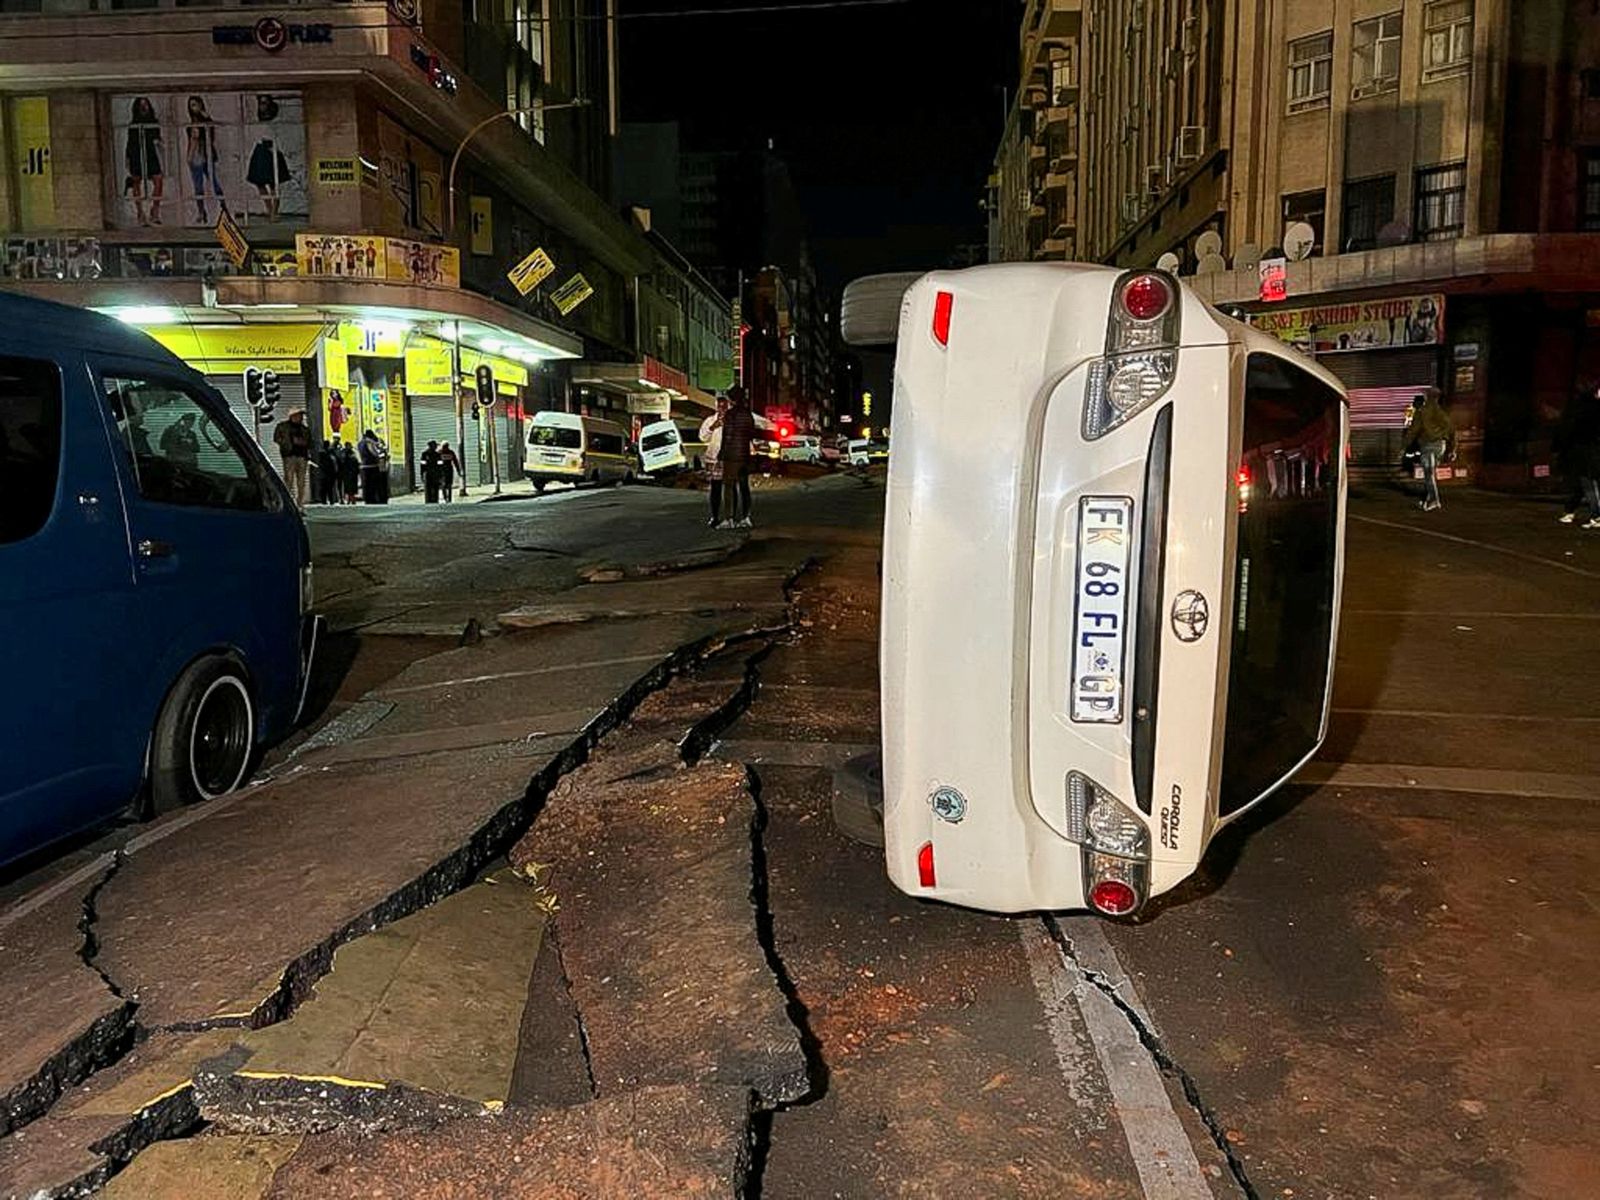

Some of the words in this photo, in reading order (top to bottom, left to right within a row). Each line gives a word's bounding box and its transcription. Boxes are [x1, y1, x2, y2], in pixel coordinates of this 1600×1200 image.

[319, 161, 354, 169] WELCOME
[319, 172, 354, 181] UPSTAIRS
[1301, 304, 1361, 327] FASHION
[1363, 299, 1413, 321] STORE
[247, 345, 265, 356] Style
[1086, 507, 1123, 545] FK
[1085, 562, 1121, 598] 68
[1081, 611, 1118, 648] FL
[1079, 675, 1116, 712] GP
[1160, 807, 1170, 848] QUEST
[1169, 784, 1182, 850] COROLLA
